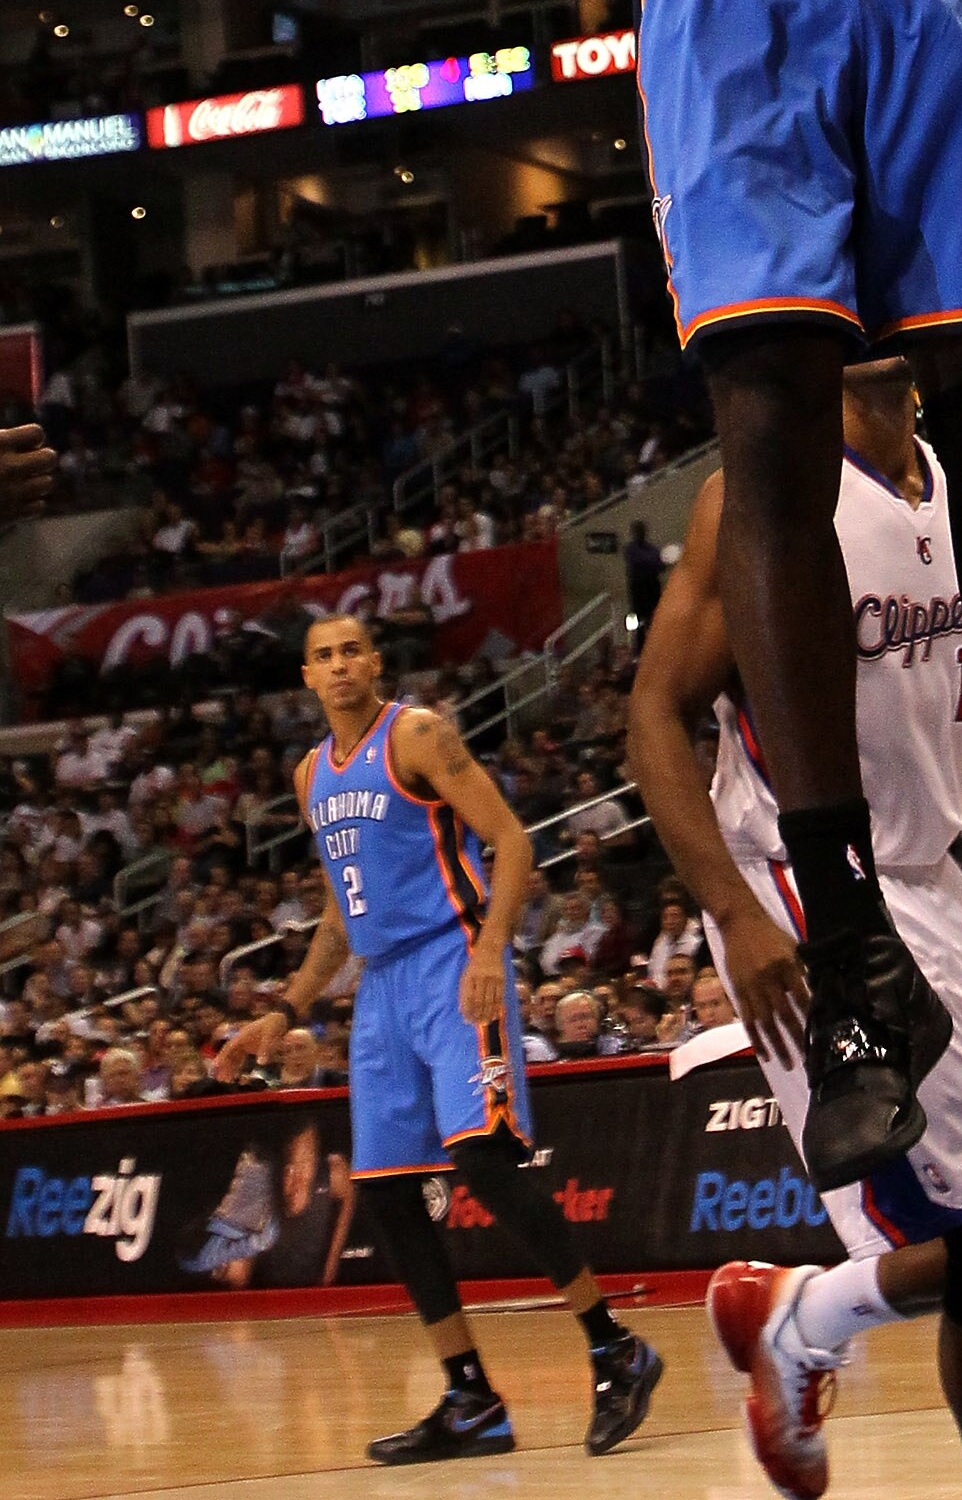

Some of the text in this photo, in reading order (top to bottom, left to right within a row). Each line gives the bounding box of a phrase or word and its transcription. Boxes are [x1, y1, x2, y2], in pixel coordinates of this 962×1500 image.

[43, 115, 131, 144] MANUEL
[325, 827, 360, 861] CITY
[342, 864, 368, 917] 2
[705, 1096, 787, 1132] ZIGT
